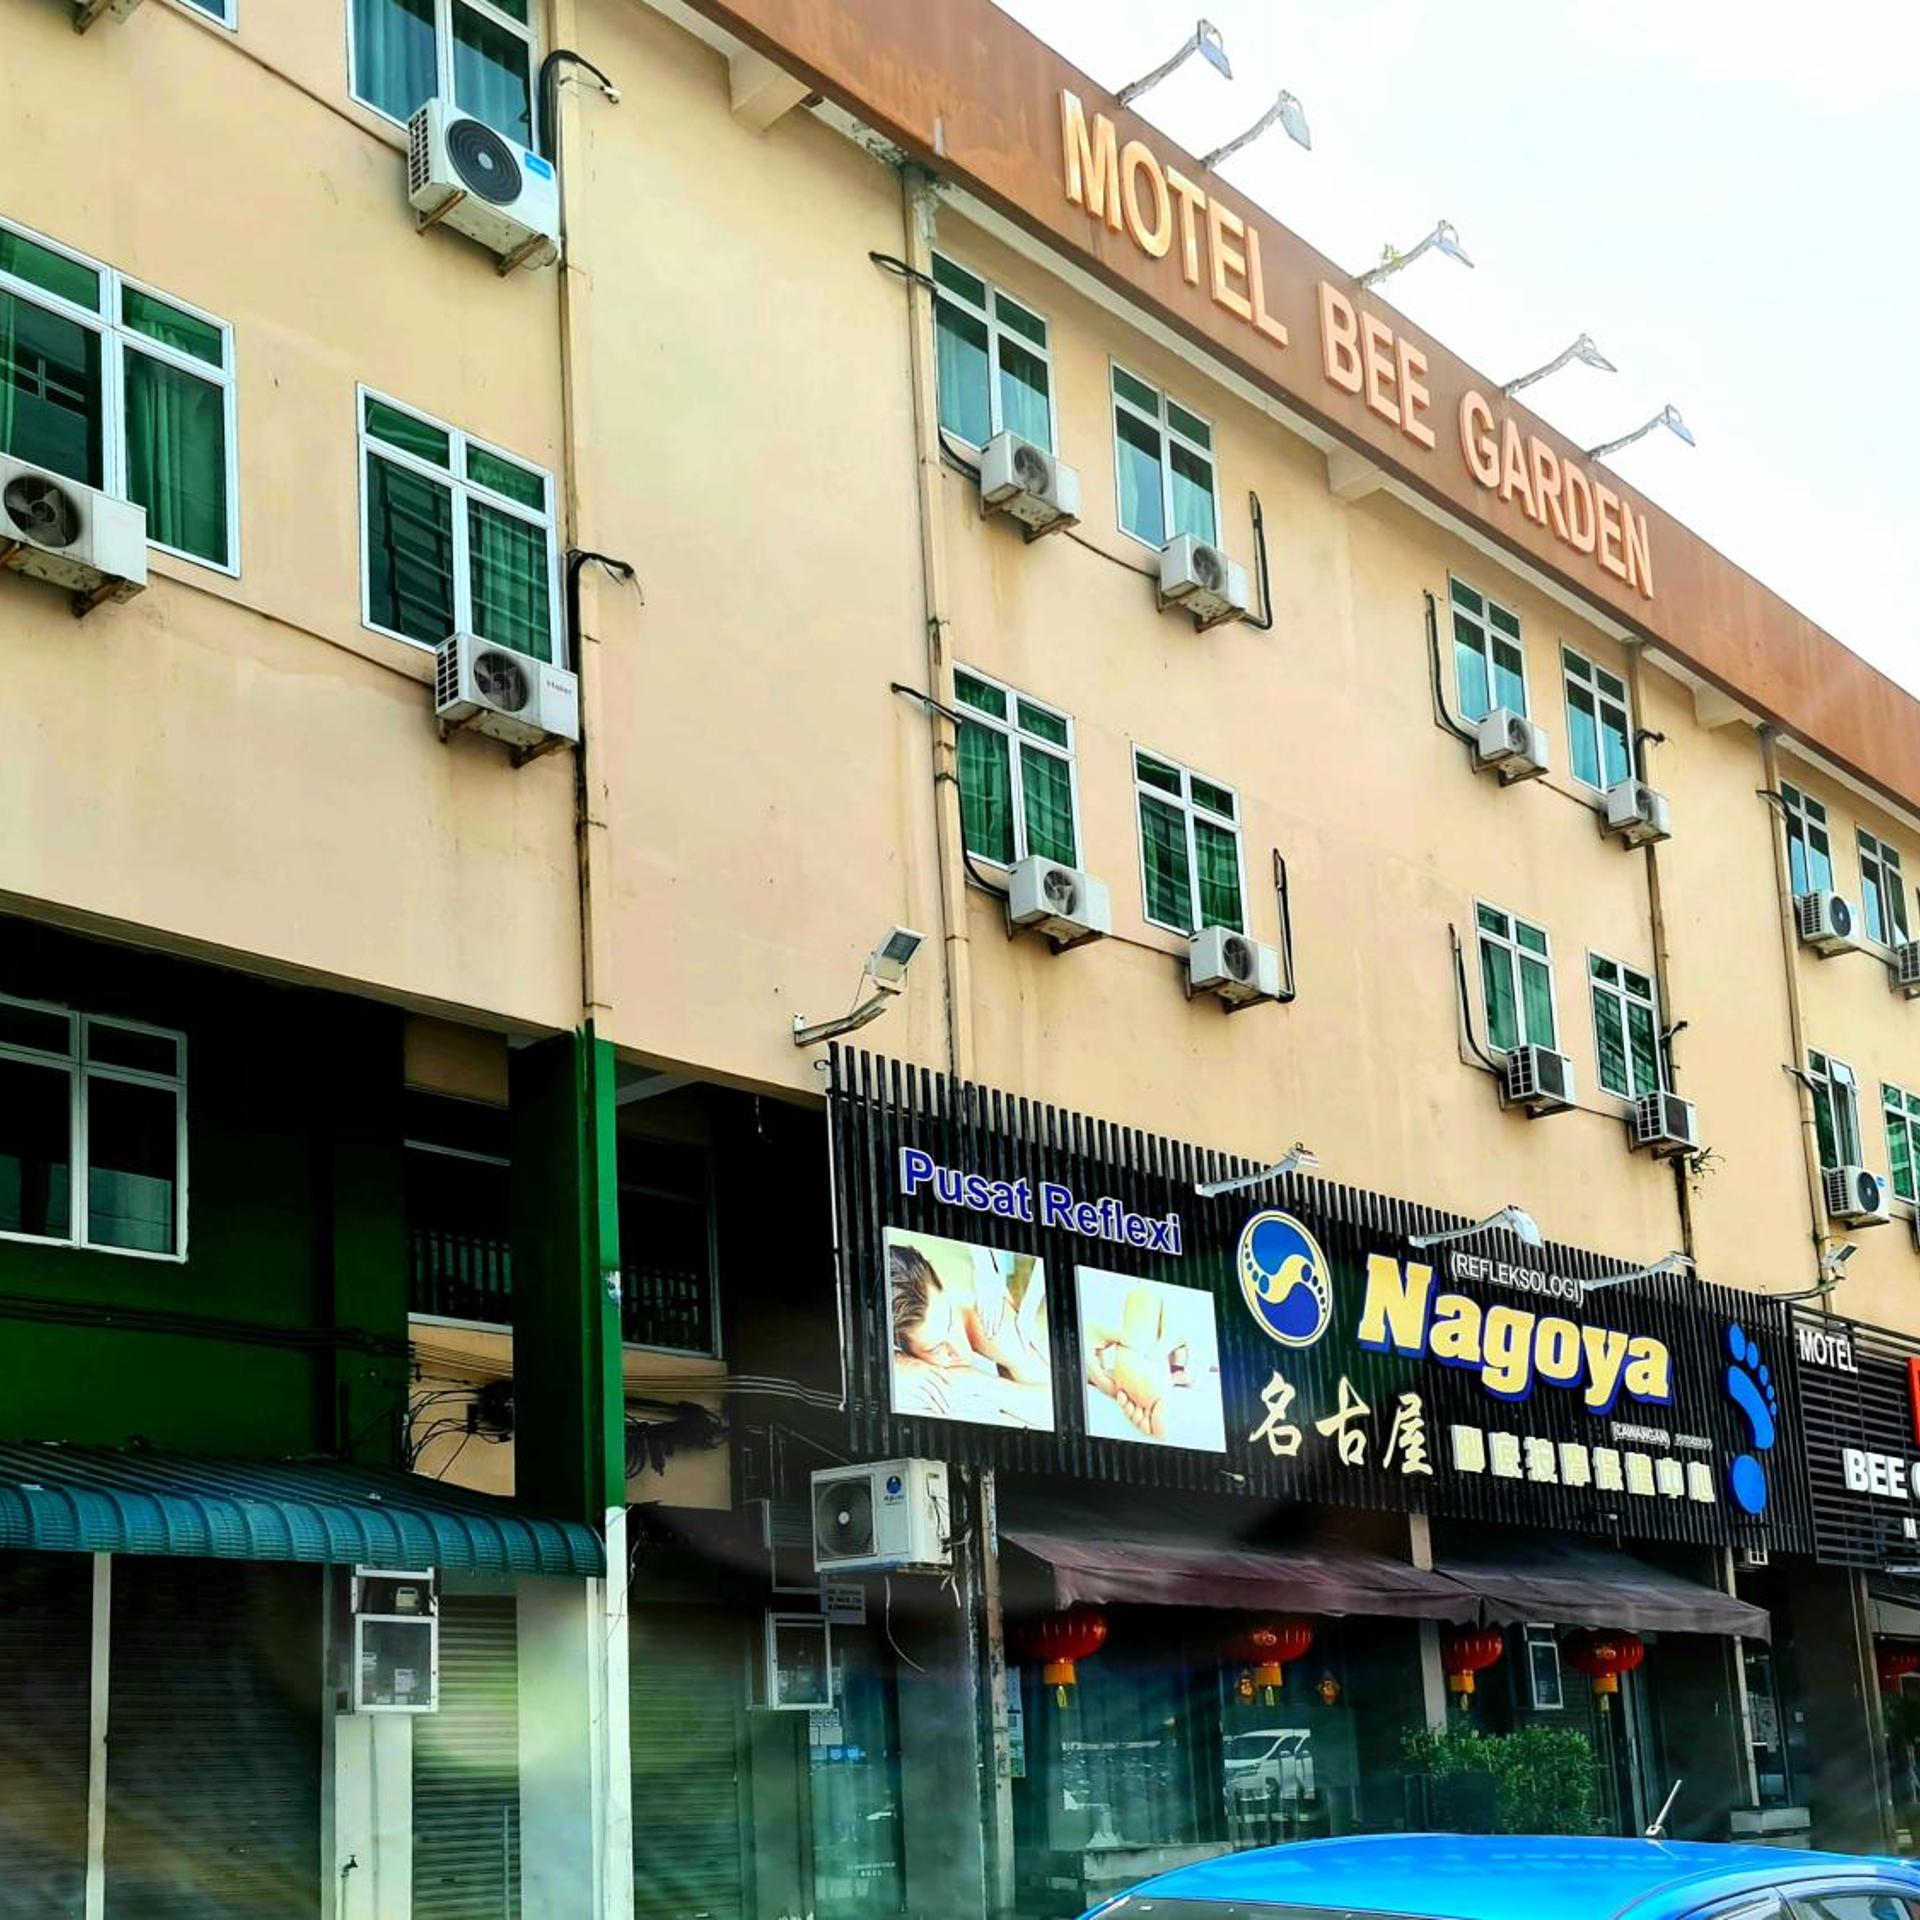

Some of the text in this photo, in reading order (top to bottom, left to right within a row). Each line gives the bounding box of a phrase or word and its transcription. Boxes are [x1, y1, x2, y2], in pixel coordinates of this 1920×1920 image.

[1060, 88, 1654, 600] MOTEL BEE GARDEN
[899, 1145, 1183, 1256] Pusat Reflexi
[1450, 1250, 1585, 1309] (REFLEKSOLOGI)
[1357, 1253, 1673, 1415] Nagoya
[1798, 1327, 1859, 1374] MOTEL
[1247, 1369, 1435, 1476] 名古屋
[1841, 1447, 1909, 1500] BEE
